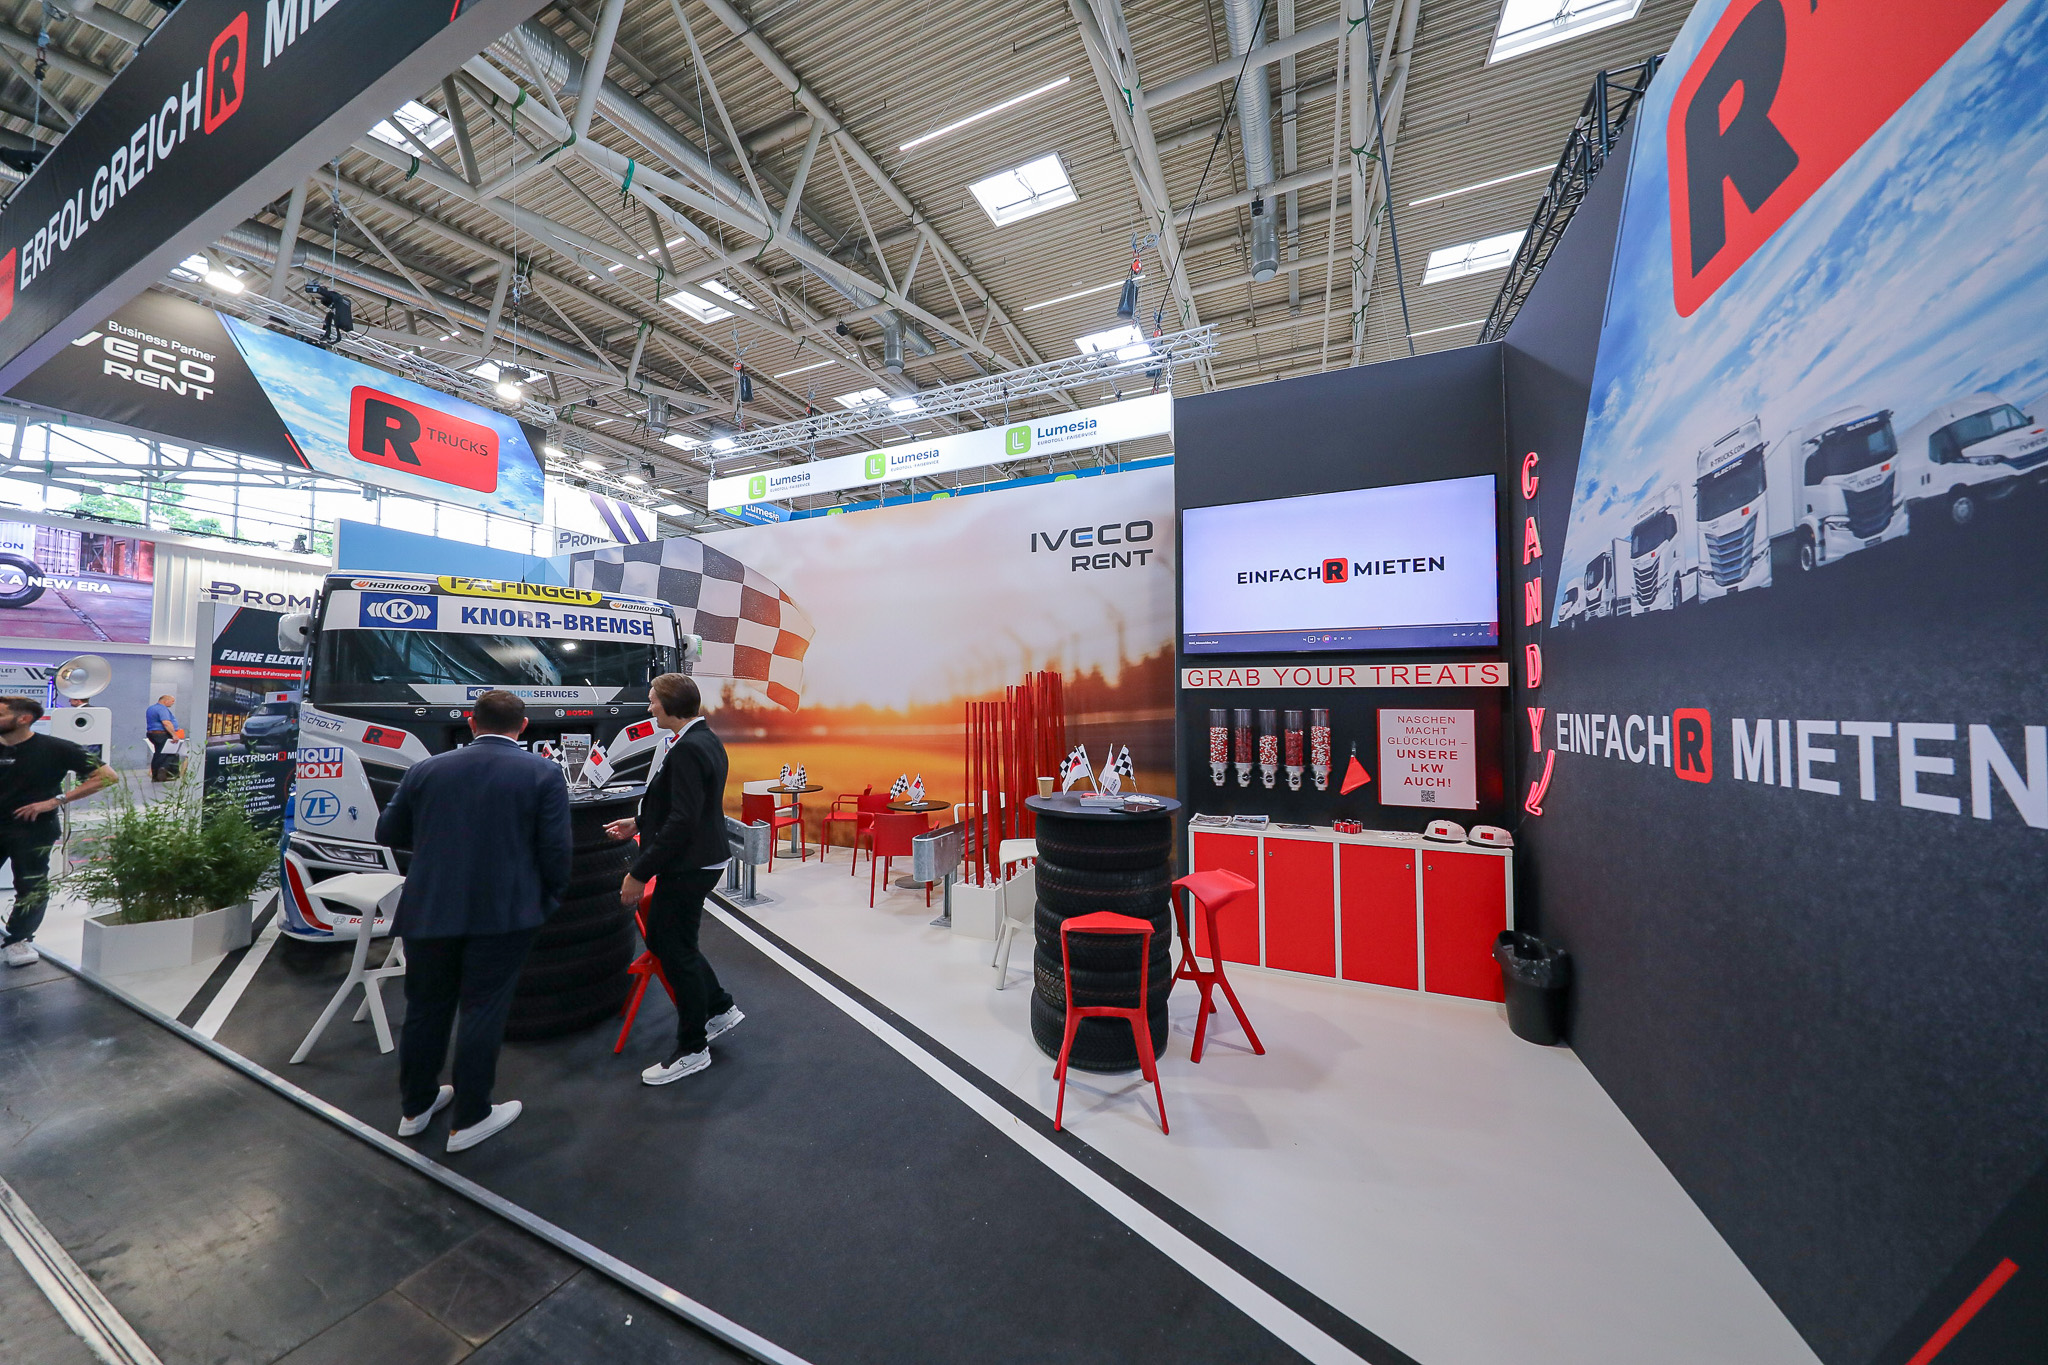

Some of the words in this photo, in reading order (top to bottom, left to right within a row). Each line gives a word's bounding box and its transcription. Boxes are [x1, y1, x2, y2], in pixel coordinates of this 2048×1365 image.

[20, 67, 204, 291] ERFOLGREICH
[108, 320, 169, 348] Business
[171, 340, 217, 363] Partner
[103, 359, 214, 401] RENT
[362, 398, 422, 467] R
[427, 427, 489, 457] TRUCKS
[1037, 418, 1097, 439] Lumesia
[891, 448, 940, 466] Lumesia
[1710, 442, 1746, 468] R-TRUCKS.COM
[770, 471, 811, 487] Lumesia
[1031, 520, 1154, 553] IVECO
[1071, 549, 1154, 572] RENT
[1237, 566, 1321, 585] EINFACH
[1326, 561, 1344, 581] R
[1353, 555, 1445, 577] MIETEN
[8, 575, 23, 586] A
[28, 576, 73, 590] NEW
[77, 581, 112, 594] ERA
[208, 580, 312, 609] PROM
[450, 576, 593, 601] PALFINGER
[1521, 452, 1546, 753] CANDY
[461, 606, 654, 637] KNORR-BREMSE
[220, 649, 264, 663] FAHRE
[1187, 669, 1261, 687] GRAB
[1273, 667, 1357, 686] YOUR
[1369, 664, 1500, 686] TREATS
[1397, 716, 1456, 724] NASCHEN
[1405, 726, 1448, 735] MACHT
[365, 728, 383, 743] R
[1387, 736, 1456, 746] GLÜCKLICH
[218, 751, 279, 765] ELEKTRISCH
[1396, 749, 1458, 760] UNSERE
[297, 763, 341, 778] MOLY
[1411, 763, 1444, 773] LKW
[1556, 713, 1671, 768] EINFACH
[1679, 718, 1706, 773] R
[1732, 718, 2048, 830] MIETEN
[1403, 776, 1452, 788] AUCH!
[303, 796, 336, 819] ZF
